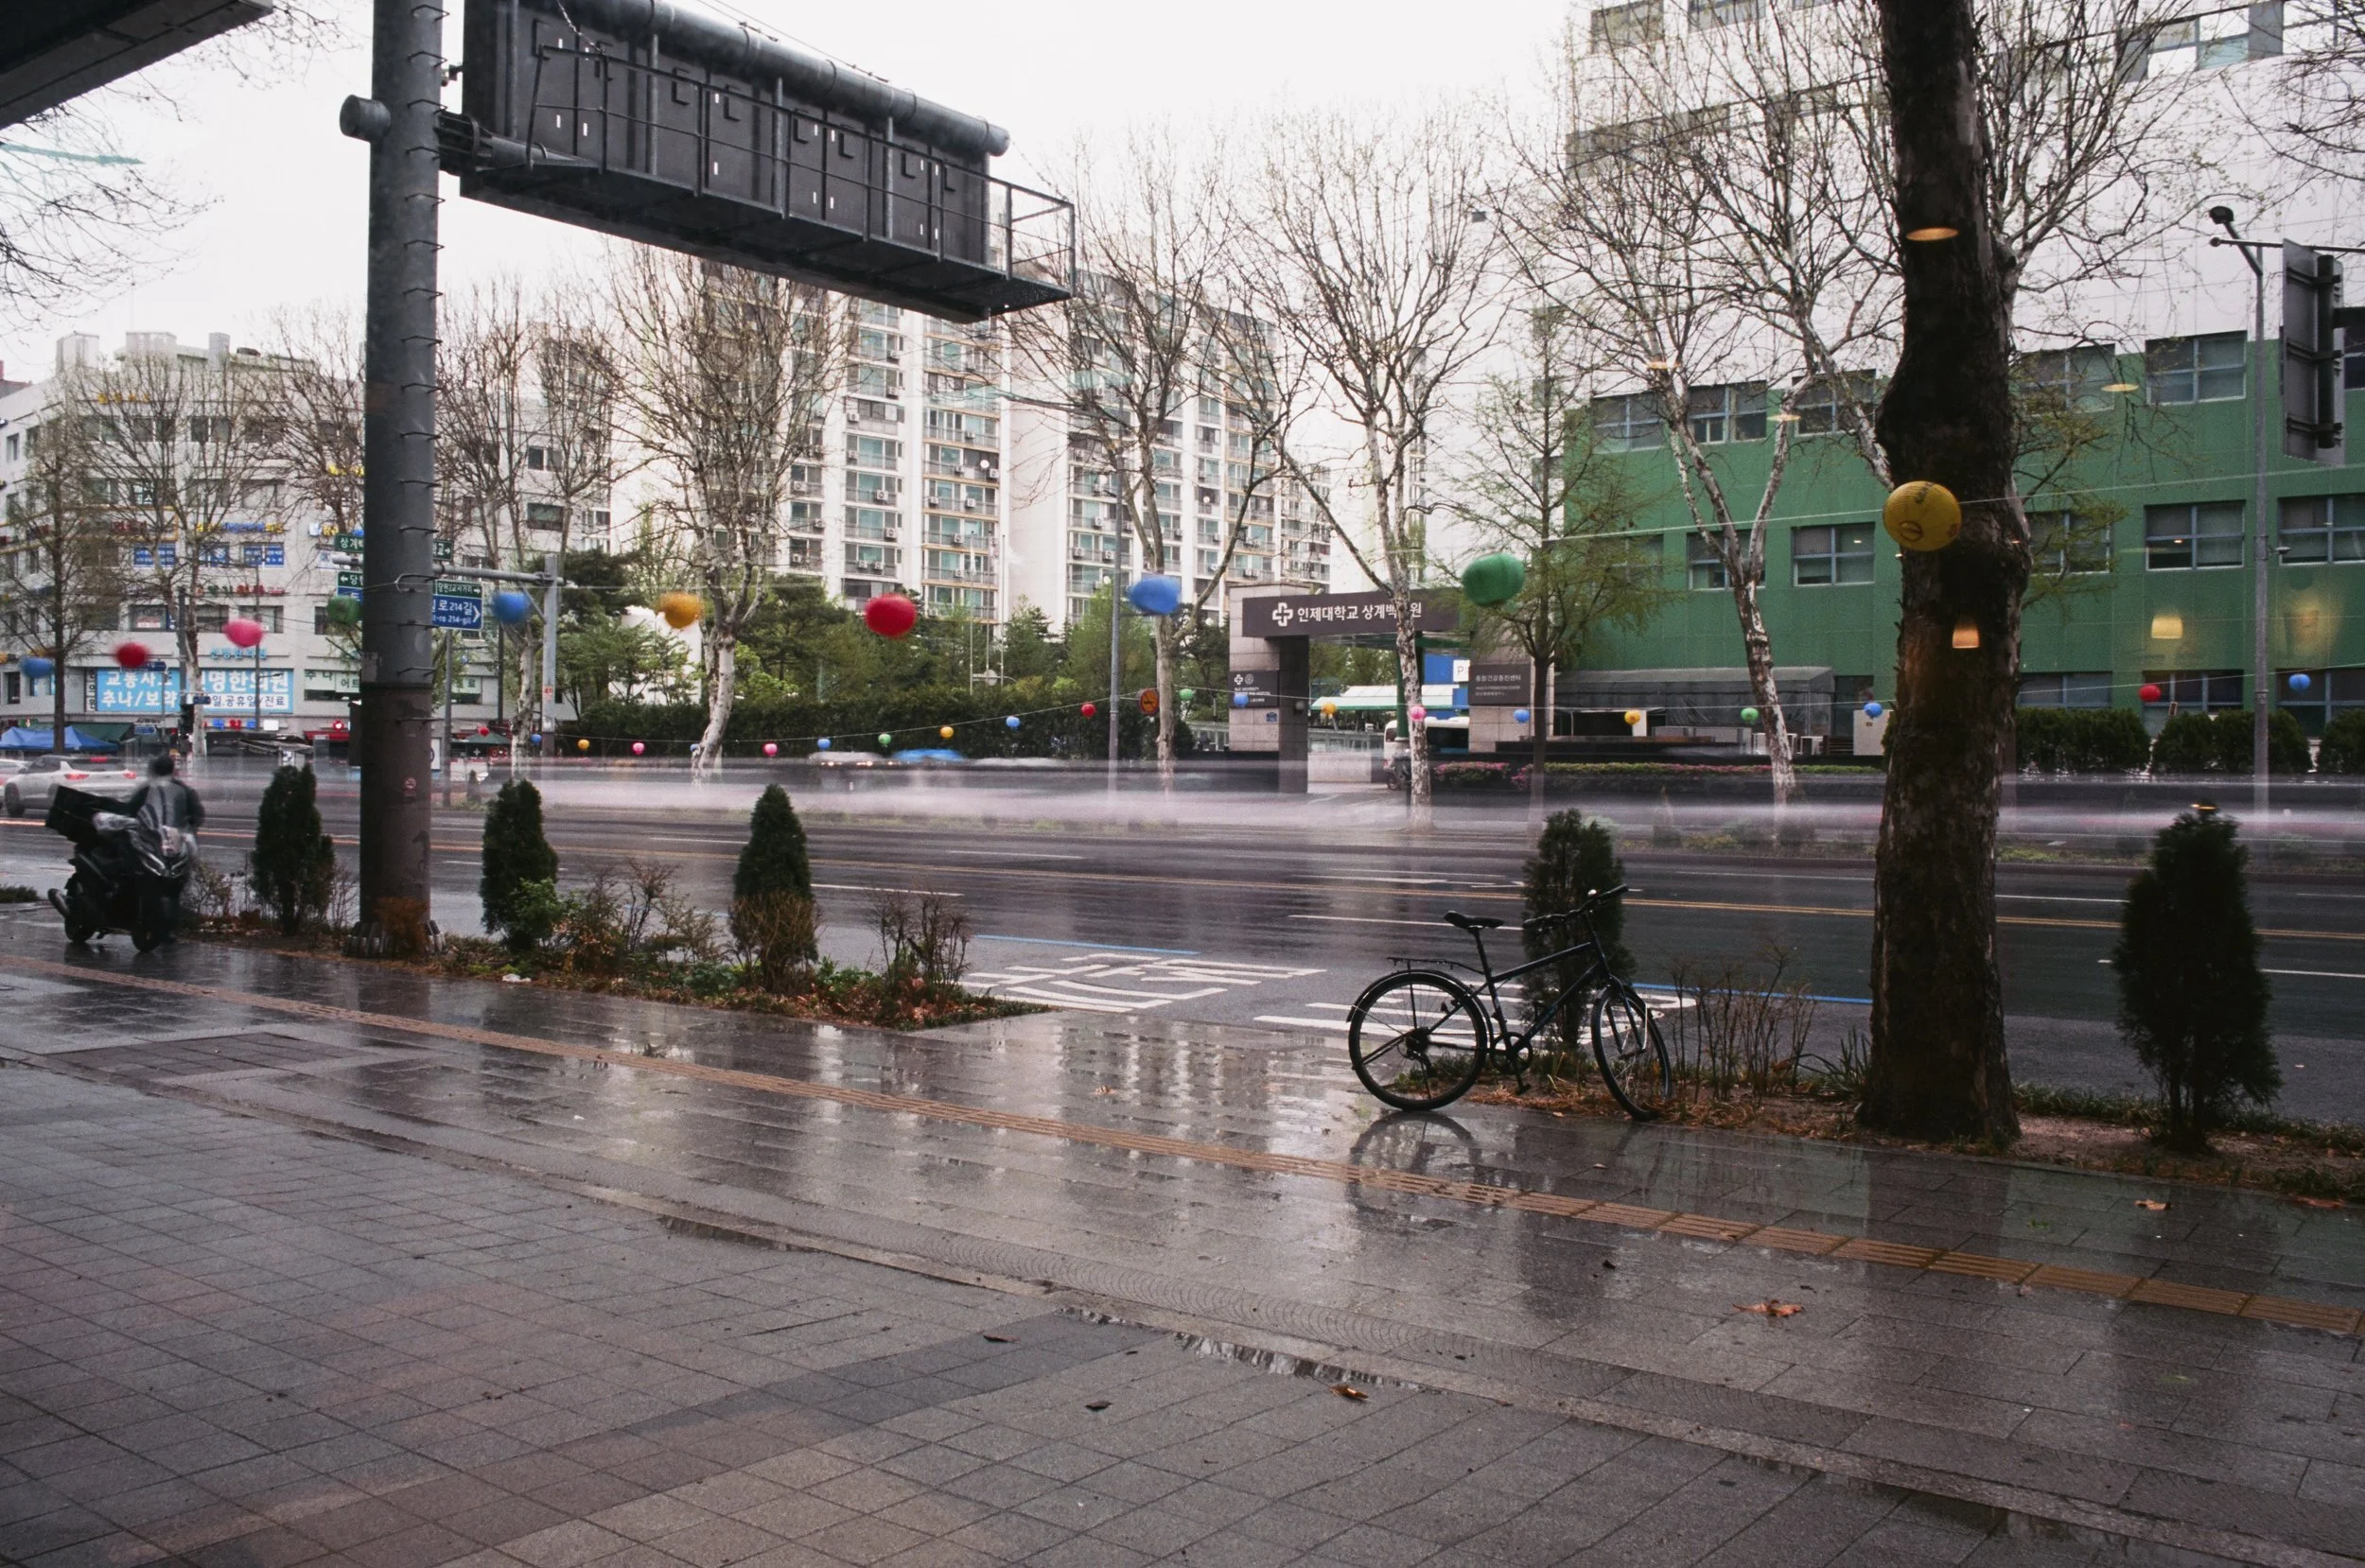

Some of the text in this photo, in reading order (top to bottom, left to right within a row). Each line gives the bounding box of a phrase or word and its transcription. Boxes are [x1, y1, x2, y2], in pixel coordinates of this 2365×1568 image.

[432, 599, 473, 616] 로214길
[1297, 602, 1422, 623] 인제대학교 상계백원
[101, 688, 178, 708] 추나/보약
